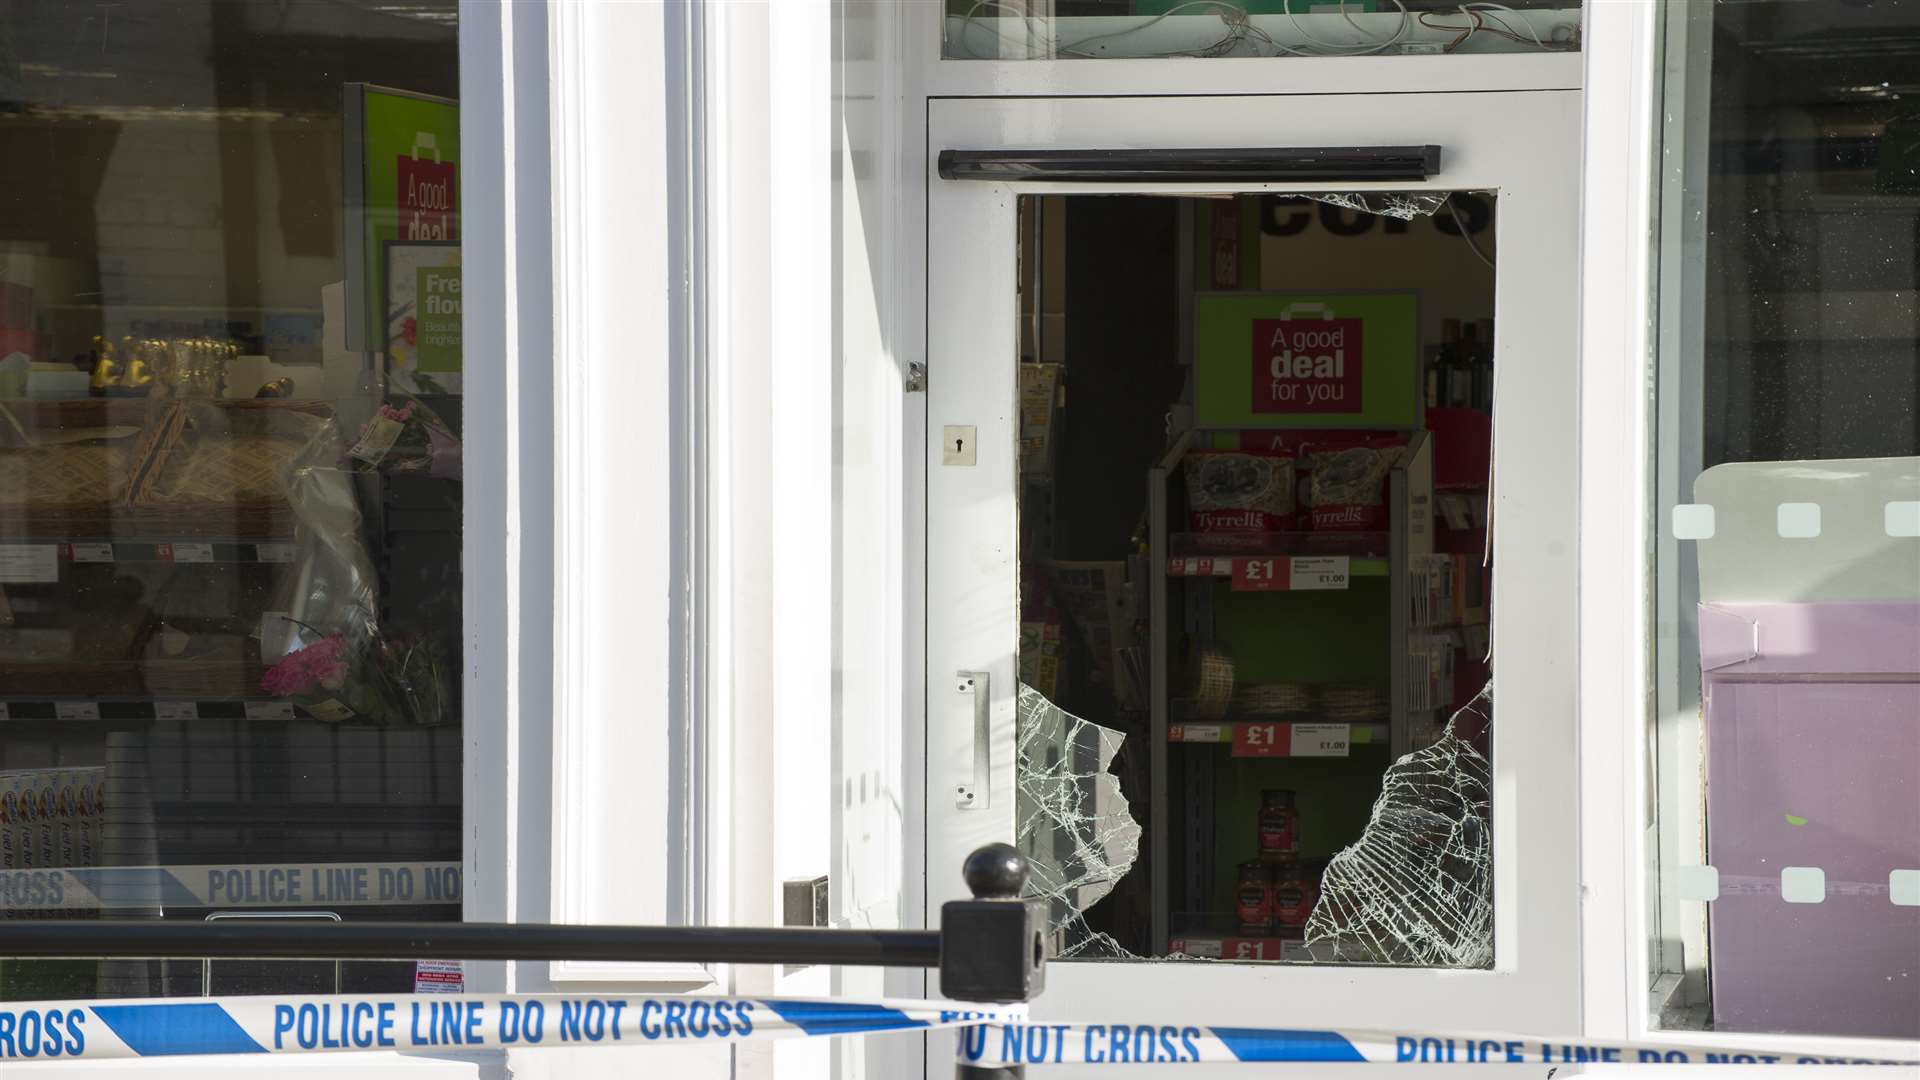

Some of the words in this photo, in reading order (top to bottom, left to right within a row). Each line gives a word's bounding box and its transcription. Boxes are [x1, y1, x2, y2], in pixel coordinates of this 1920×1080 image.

[407, 173, 418, 206] A
[419, 177, 448, 215] good
[1271, 327, 1287, 348] A
[1293, 326, 1344, 352] good
[1271, 349, 1344, 378] deal
[1271, 379, 1300, 401] for
[1306, 383, 1344, 405] you
[1246, 560, 1274, 580] £1
[1319, 574, 1345, 583] £1.00
[1246, 725, 1275, 745] £1
[1319, 741, 1345, 750] £1.00
[208, 868, 300, 903] POLICE
[312, 867, 368, 901] LINE
[379, 867, 414, 900] DO
[425, 866, 463, 900] NO
[1236, 942, 1264, 960] £1
[0, 1008, 85, 1057] ROSS
[274, 1002, 395, 1050] POLICE
[411, 1001, 484, 1046] LINE
[500, 1000, 544, 1044] DO
[560, 999, 627, 1042] NOT
[640, 999, 754, 1040] CROSS
[1001, 1024, 1070, 1064] NOT
[1084, 1024, 1200, 1064] CROSS
[1395, 1036, 1524, 1063] POLICE
